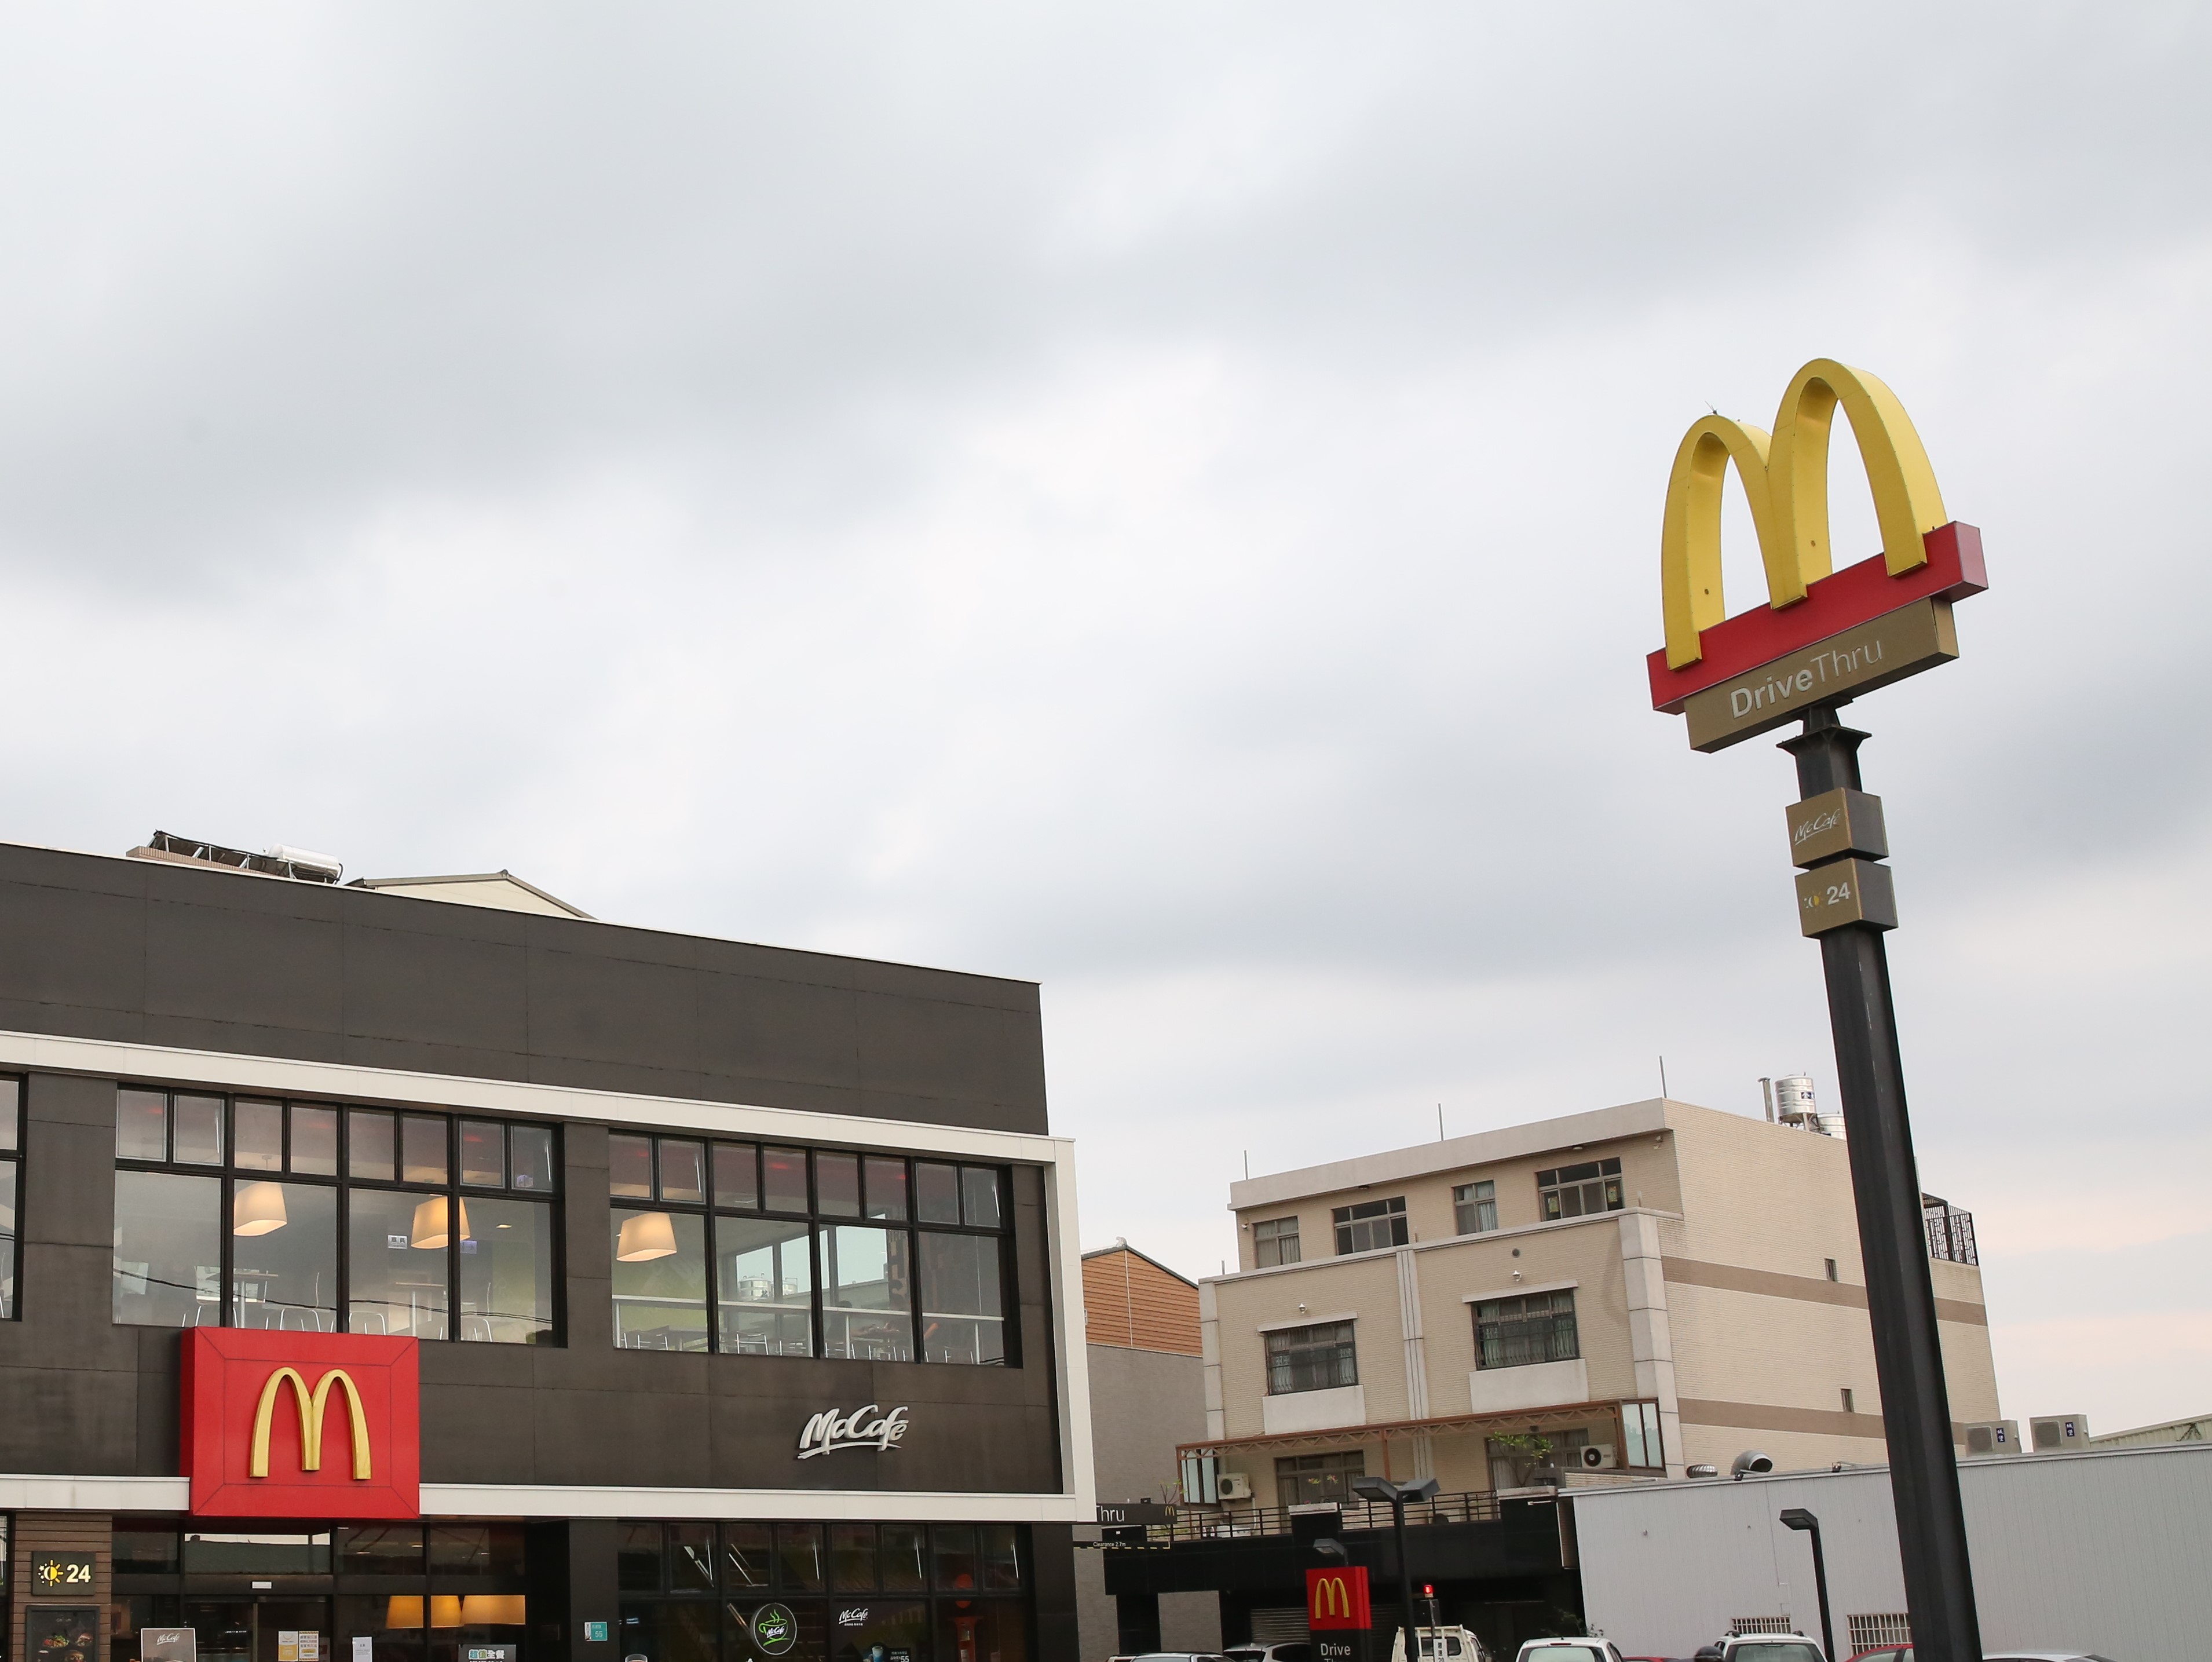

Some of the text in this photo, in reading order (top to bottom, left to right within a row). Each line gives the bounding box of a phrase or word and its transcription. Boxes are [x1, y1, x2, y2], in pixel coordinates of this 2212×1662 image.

[1826, 882, 1851, 905] 24
[798, 1404, 909, 1459] McCafé
[66, 1564, 91, 1583] 24
[1321, 1643, 1351, 1656] Drive
